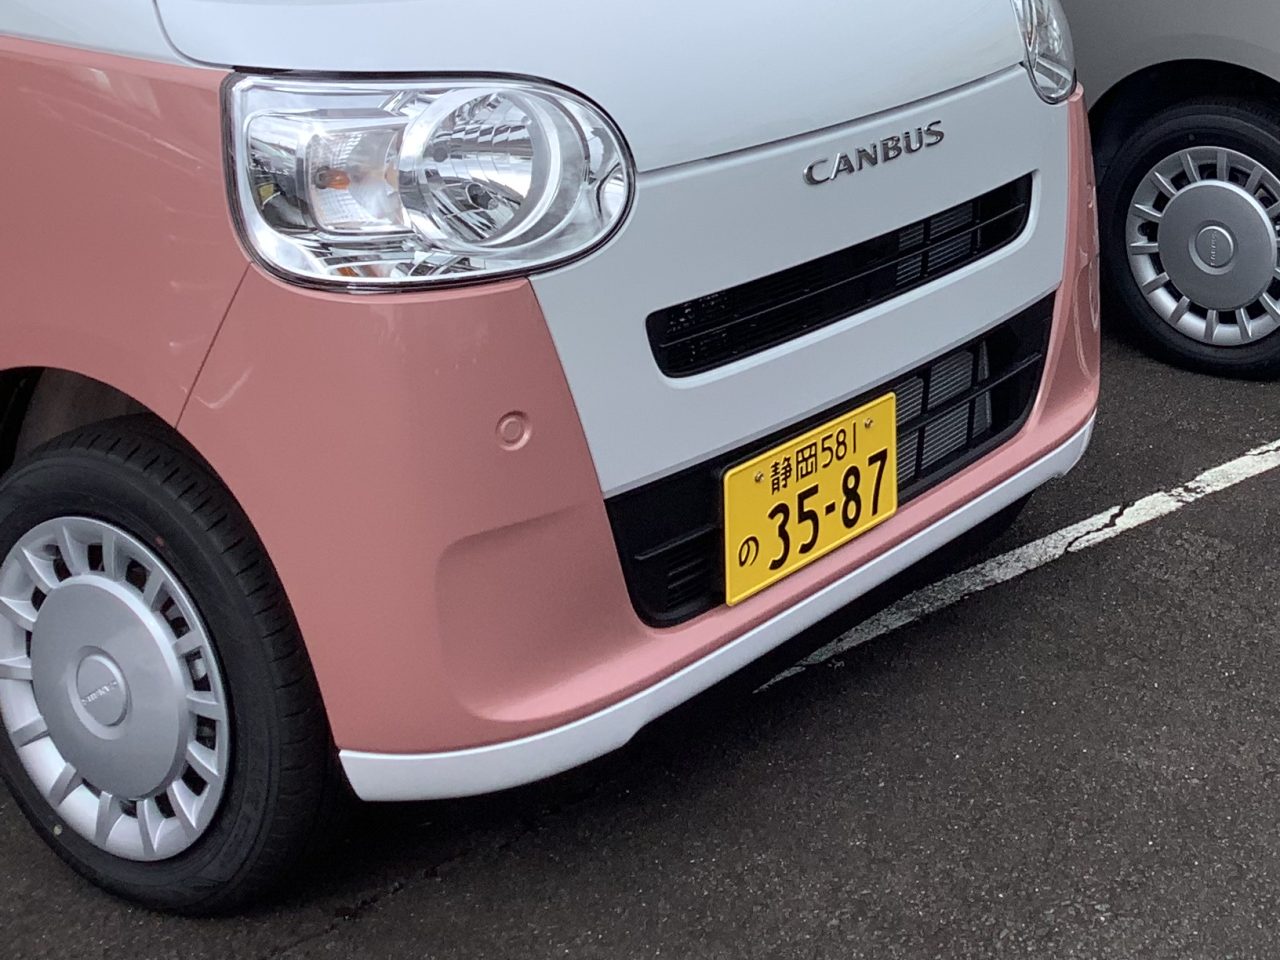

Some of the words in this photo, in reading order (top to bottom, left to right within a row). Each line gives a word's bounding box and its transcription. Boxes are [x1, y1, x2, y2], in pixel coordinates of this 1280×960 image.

[802, 119, 945, 186] CANBUS
[770, 421, 858, 495] 静岡581
[738, 535, 760, 567] の
[768, 448, 888, 570] 35-87
